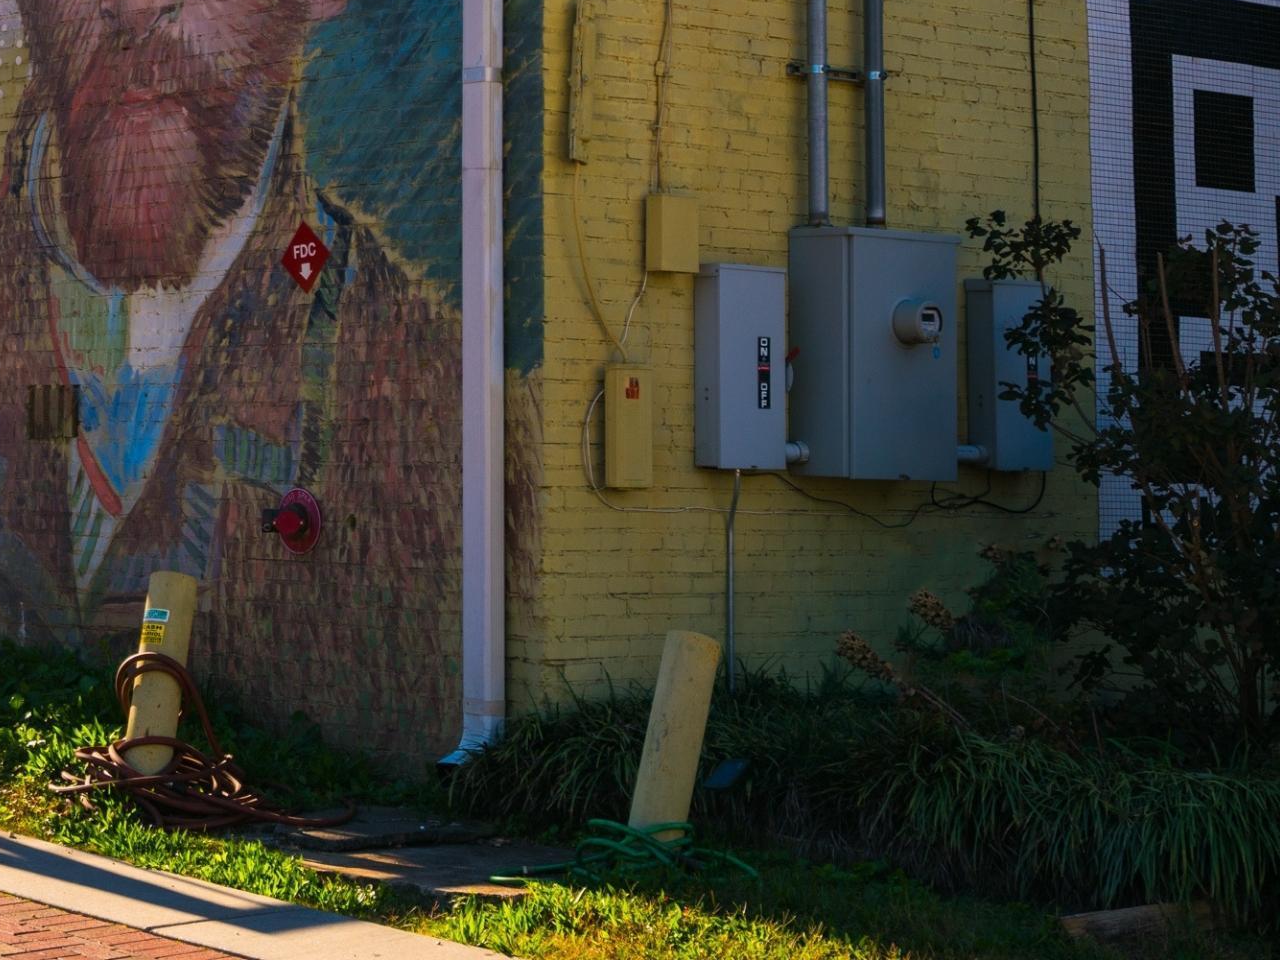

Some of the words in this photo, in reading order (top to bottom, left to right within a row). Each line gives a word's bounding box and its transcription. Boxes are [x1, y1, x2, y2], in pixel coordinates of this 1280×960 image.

[293, 242, 316, 259] FDC
[760, 338, 768, 356] ON
[760, 383, 768, 408] OFF
